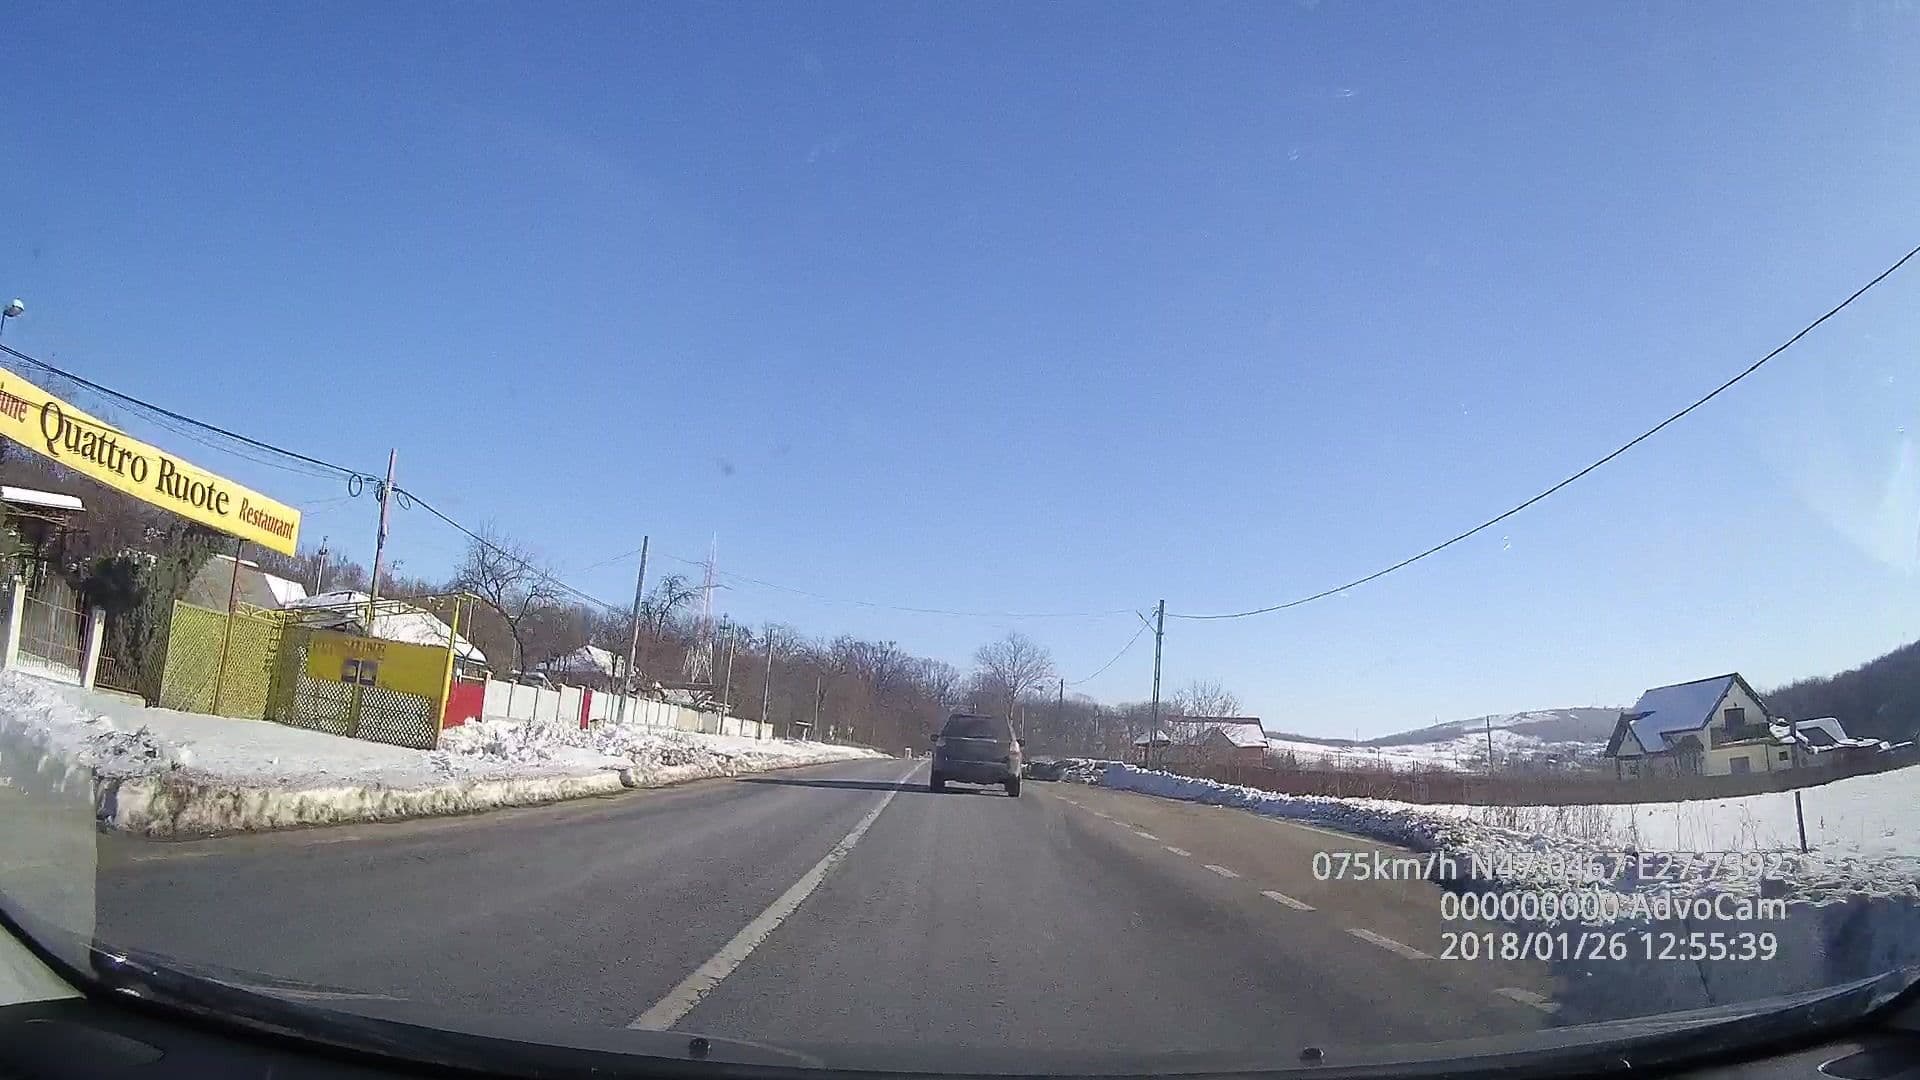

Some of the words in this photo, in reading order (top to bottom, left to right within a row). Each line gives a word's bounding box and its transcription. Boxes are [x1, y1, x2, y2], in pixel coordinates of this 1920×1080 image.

[40, 401, 148, 483] Quattro
[155, 456, 229, 515] Ruote
[239, 497, 295, 541] Restaurant
